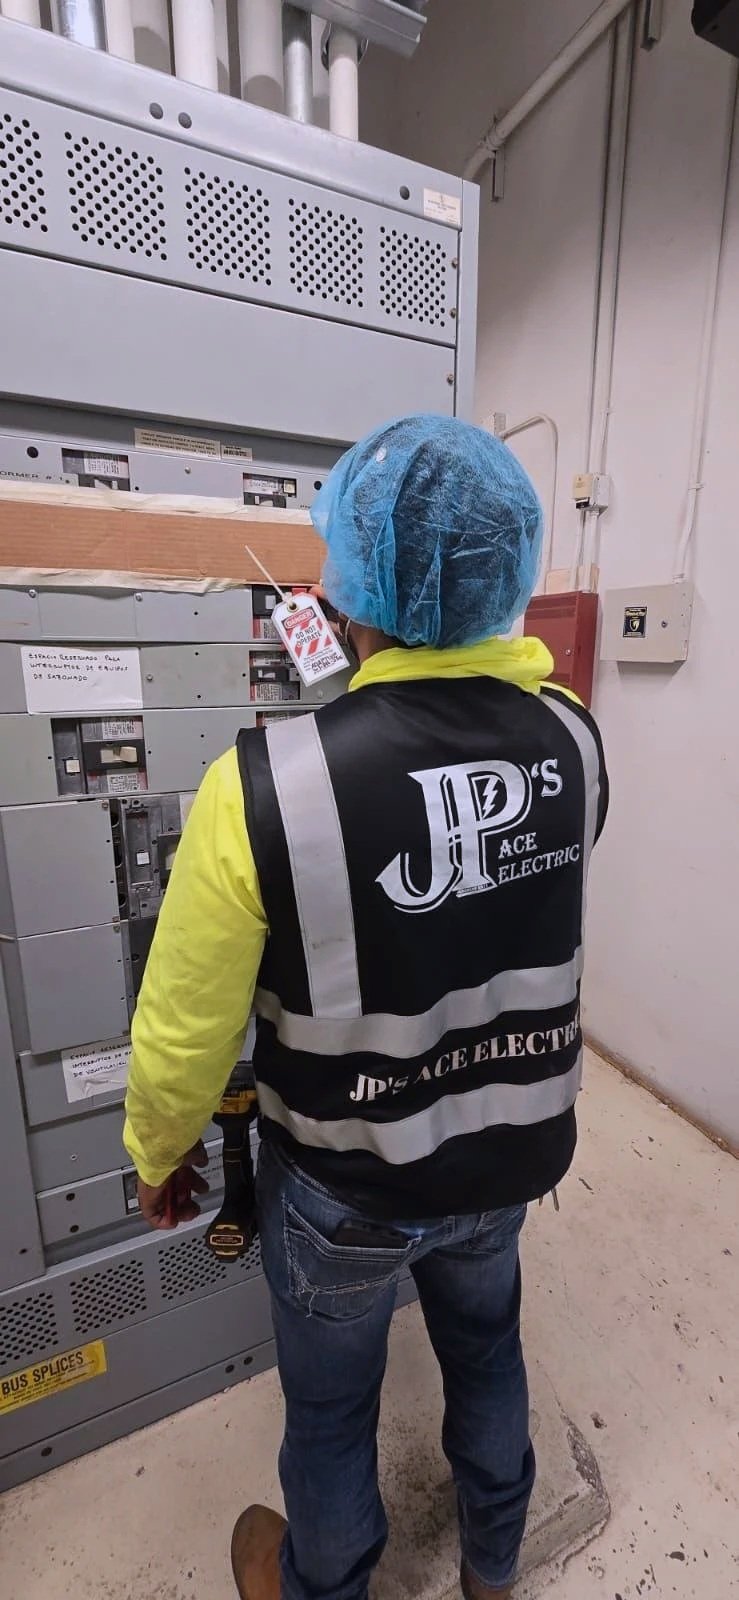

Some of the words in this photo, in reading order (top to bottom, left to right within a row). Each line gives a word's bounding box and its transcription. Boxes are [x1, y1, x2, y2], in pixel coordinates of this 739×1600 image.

[295, 630, 305, 640] DO
[305, 624, 317, 636] NOT
[296, 631, 323, 648] OPERATE
[498, 832, 538, 860] ACE
[498, 844, 581, 885] ELECTRIC
[414, 1047, 468, 1085] ACE
[1, 1373, 29, 1395] BUS
[32, 1351, 84, 1382] SPLICES
